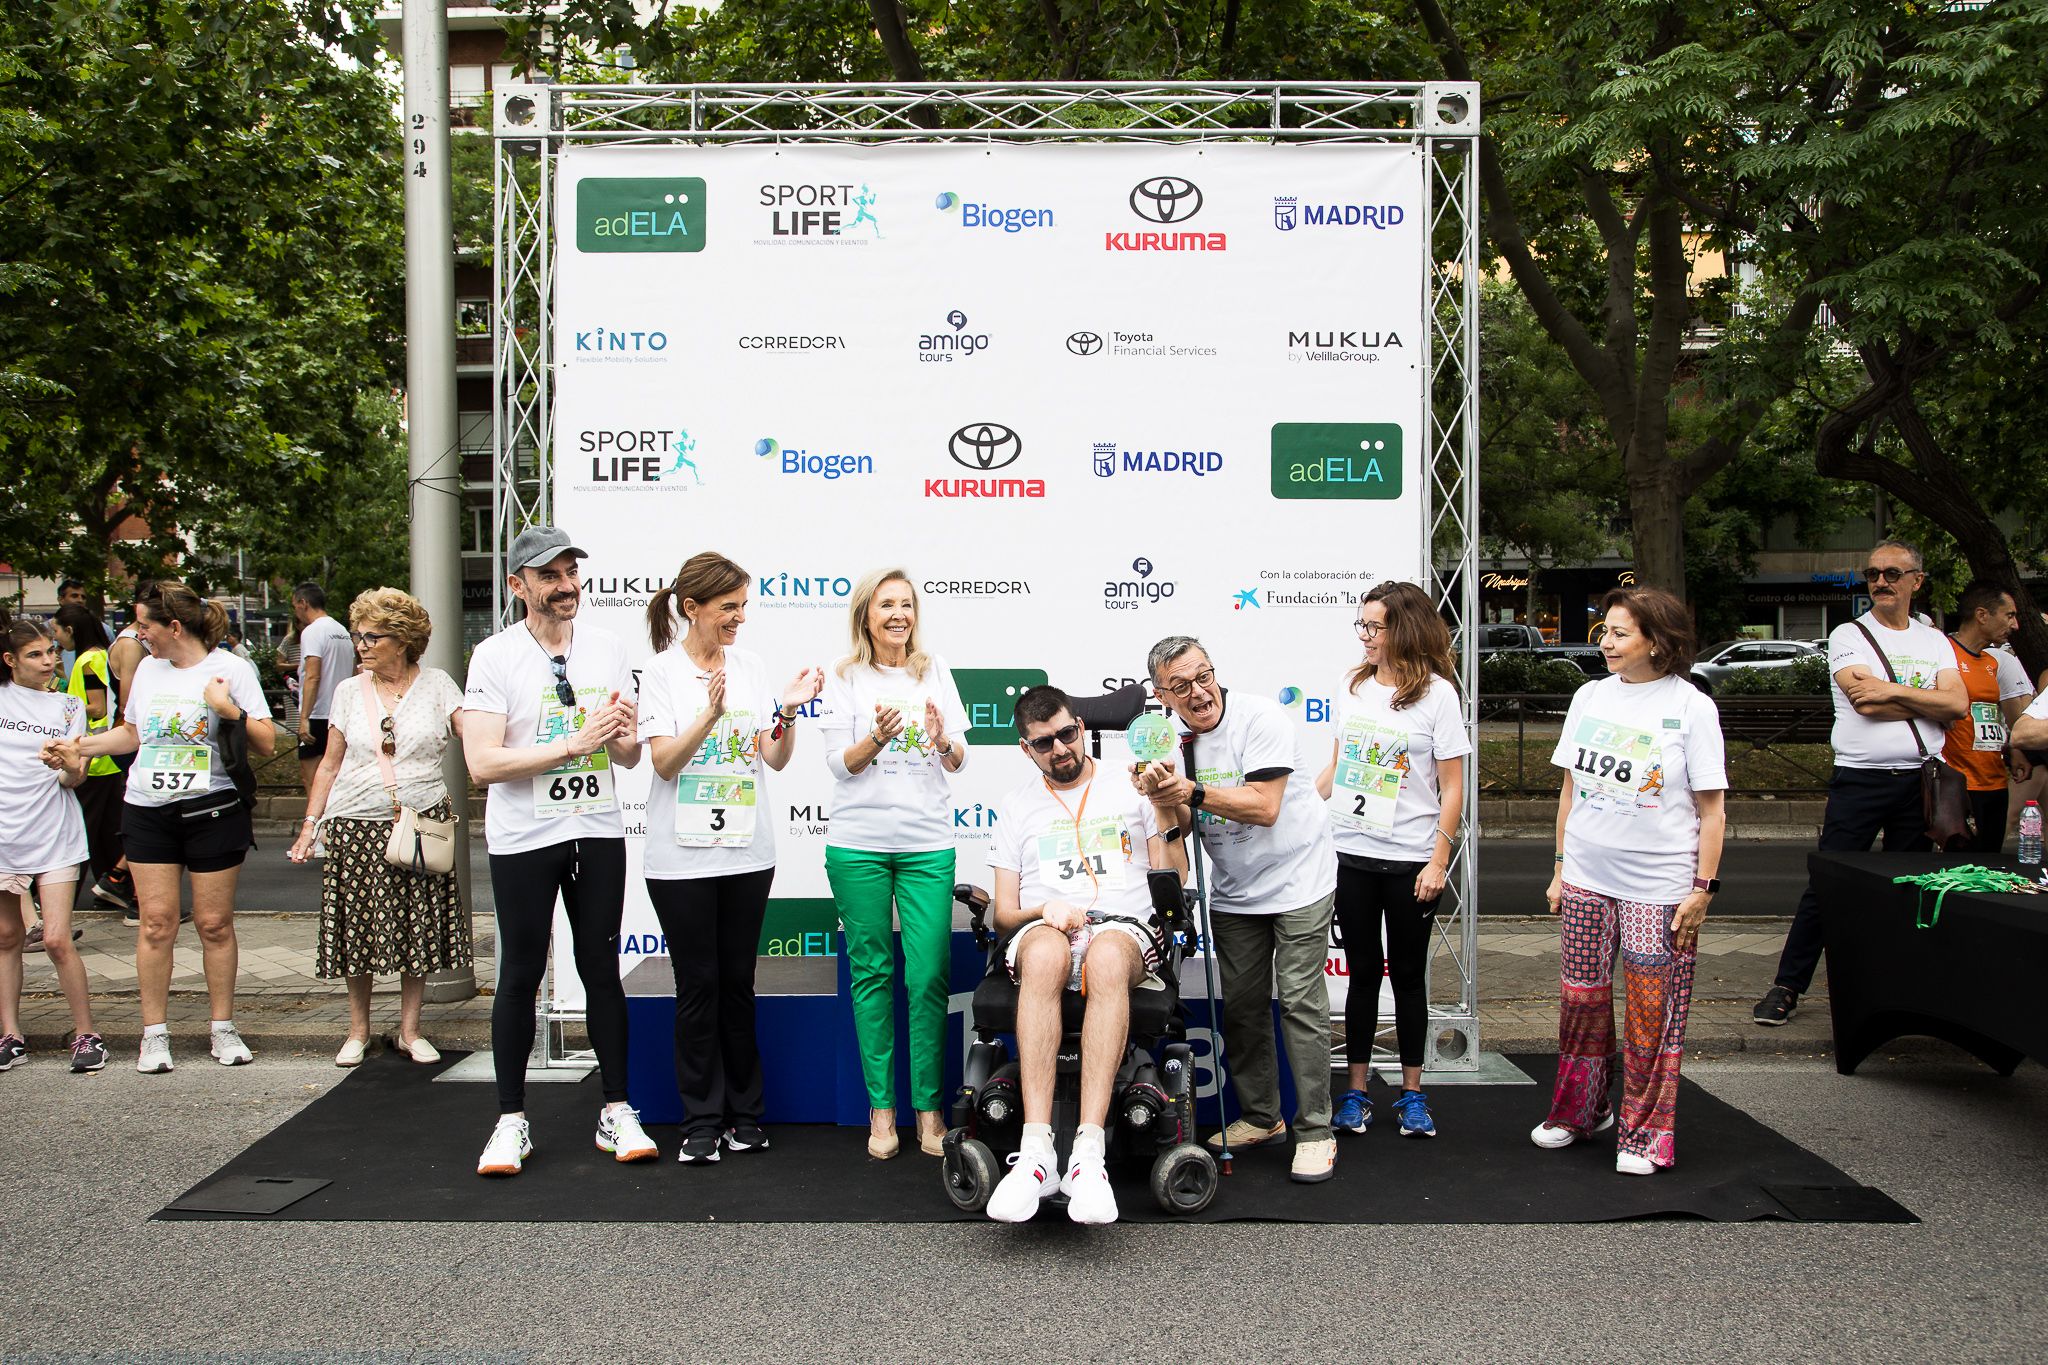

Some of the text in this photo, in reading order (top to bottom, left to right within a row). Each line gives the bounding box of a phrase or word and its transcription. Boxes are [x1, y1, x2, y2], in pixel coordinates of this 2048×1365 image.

[760, 184, 854, 207] SPORT
[594, 211, 688, 236] adELA
[773, 211, 841, 236] LIFE
[962, 203, 1054, 233] Biogen
[1304, 205, 1404, 230] MADRID
[919, 334, 989, 356] amigo
[1113, 331, 1153, 344] Toyota
[1289, 331, 1403, 348] MUKUA
[576, 355, 603, 364] Flexible
[634, 355, 667, 364] Solutions
[919, 351, 953, 362] tours
[1114, 345, 1217, 356] Financial Services
[1288, 351, 1380, 363] by VelillaGroup.
[579, 430, 674, 453] SPORT
[592, 457, 660, 482] LIFE
[782, 450, 873, 480] Biogen
[1123, 451, 1223, 477] MADRID
[1289, 457, 1384, 483] adELA
[1260, 571, 1375, 580] Con la colaboración de:
[1104, 581, 1175, 604] amigo
[1266, 590, 1338, 605] Fundación
[1748, 593, 1852, 603] Centro de Rehabilitac
[760, 601, 849, 610] Flexible Mobility Solution
[1105, 598, 1139, 610] tours
[578, 687, 596, 696] CON
[1574, 747, 1633, 783] 1198
[152, 771, 197, 790] 537
[549, 774, 600, 801] 698
[1352, 794, 1366, 817] 2
[709, 808, 726, 832] 3
[789, 826, 804, 838] by
[954, 832, 981, 840] Flexible
[1058, 854, 1107, 880] 341
